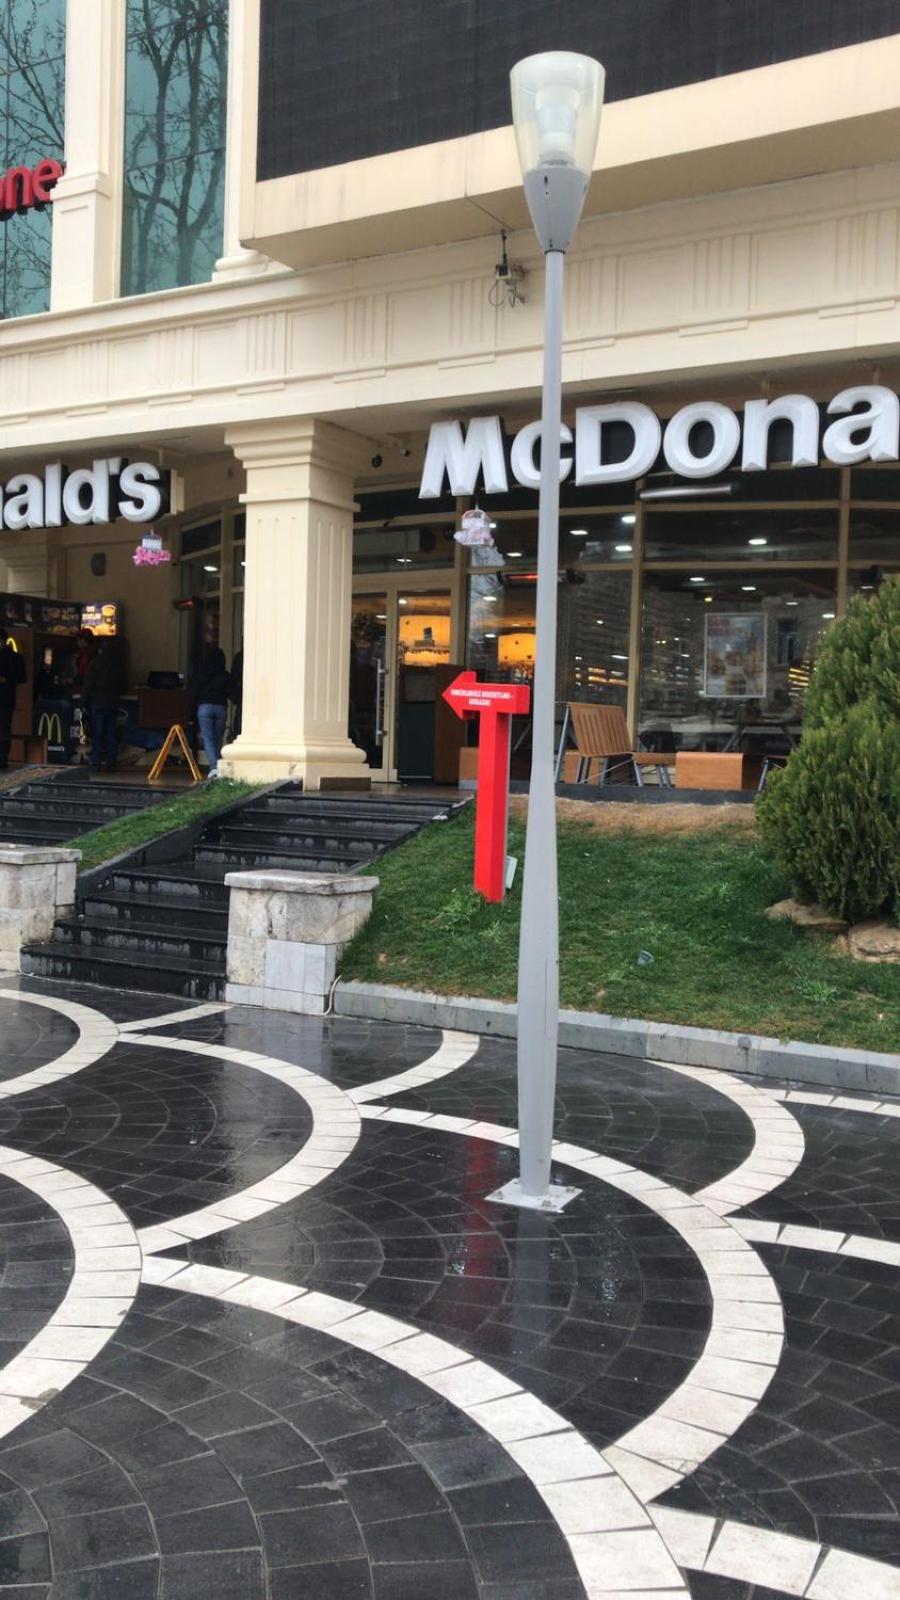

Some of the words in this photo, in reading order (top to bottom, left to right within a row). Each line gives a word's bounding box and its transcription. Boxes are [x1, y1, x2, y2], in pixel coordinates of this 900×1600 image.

[0, 158, 63, 213] ne
[418, 385, 900, 499] McDona
[0, 456, 162, 531] ald's
